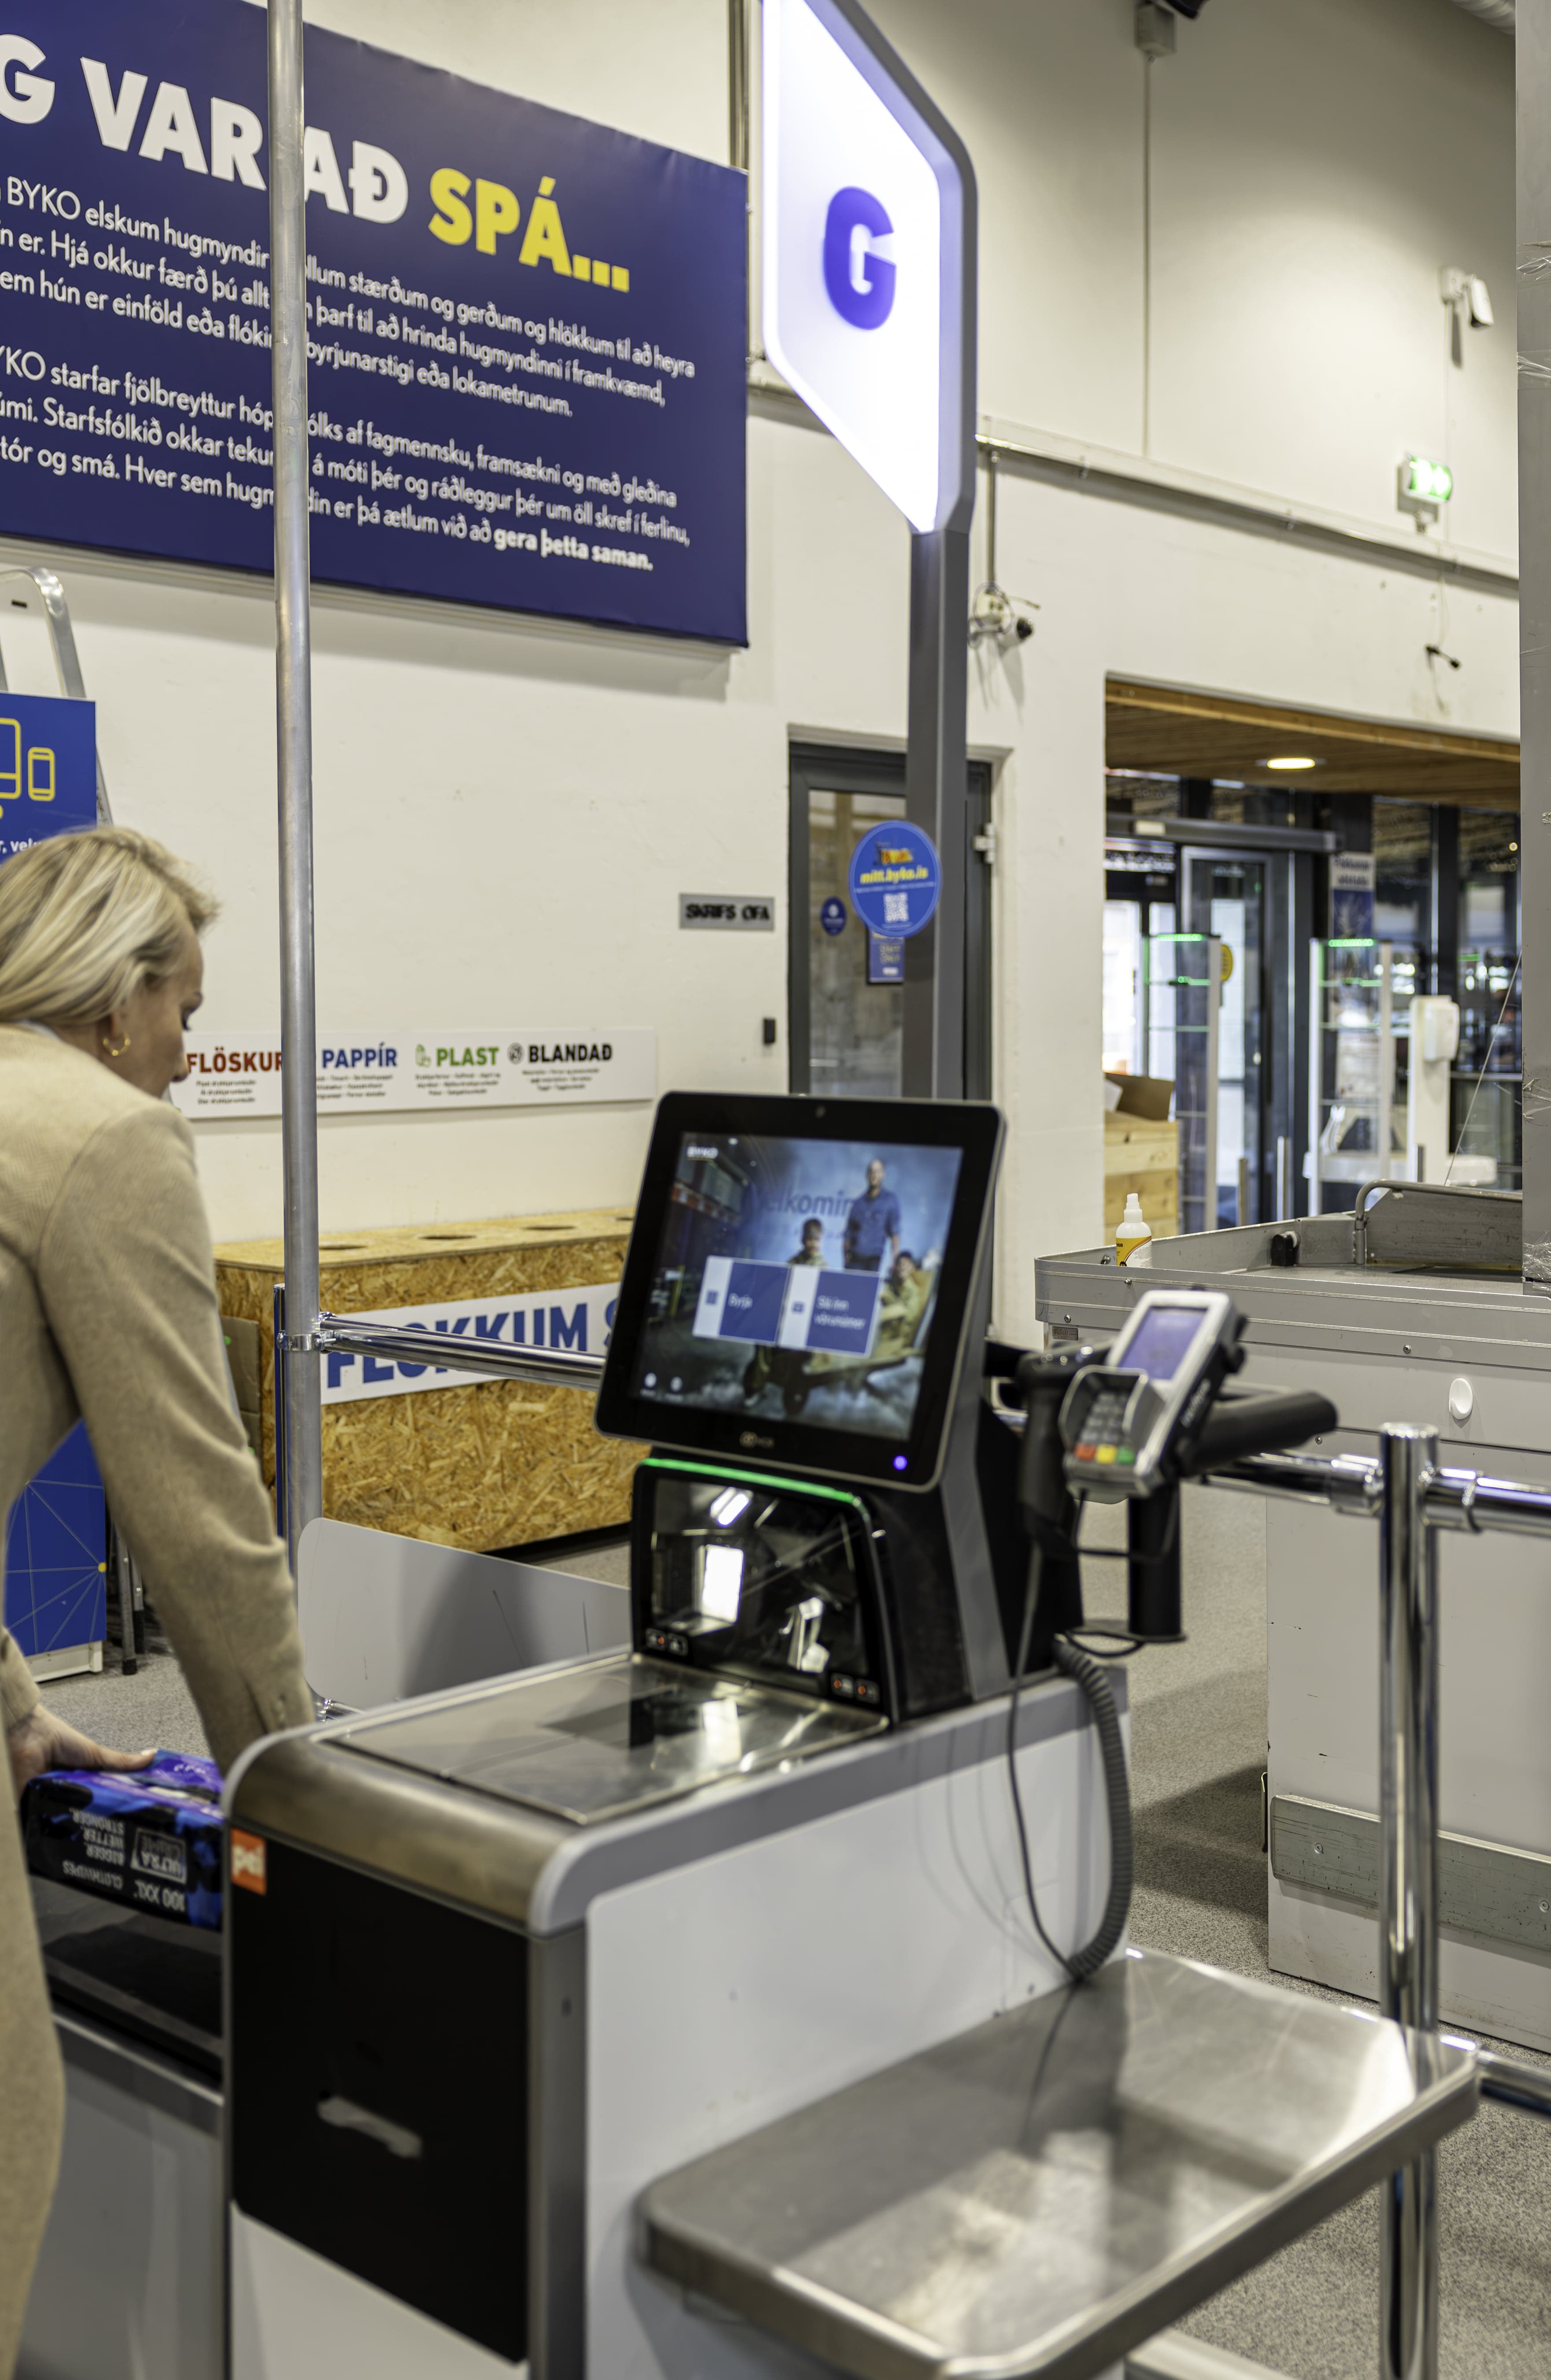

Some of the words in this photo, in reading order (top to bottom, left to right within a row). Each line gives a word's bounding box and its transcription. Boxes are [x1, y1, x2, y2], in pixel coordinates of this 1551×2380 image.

[80, 57, 267, 191] VAR
[428, 167, 629, 293] SPÁ...
[7, 176, 81, 220] BYKO
[85, 199, 160, 242] elskum
[164, 216, 270, 269] hugmyndir
[305, 254, 346, 289] llum
[348, 271, 429, 310] stærðum
[430, 296, 455, 322] og
[456, 301, 523, 335] gerðum
[524, 320, 547, 345] og
[616, 337, 631, 362] til
[632, 341, 653, 367] að
[653, 344, 695, 379] heyra
[18, 233, 46, 255] er.
[51, 229, 89, 269] Hjá
[93, 243, 155, 281] okkur
[158, 256, 209, 294] færð
[212, 269, 238, 303] þú
[241, 279, 270, 310] allt
[316, 294, 355, 330] þarf
[356, 307, 374, 335] til
[375, 312, 400, 340] að
[402, 316, 458, 355] hrinda
[459, 330, 563, 381] hugmyndinni
[822, 185, 896, 331] G
[40, 269, 81, 306] hún
[85, 291, 109, 311] er
[112, 293, 183, 329] einföld
[186, 306, 225, 338] eða
[416, 359, 450, 390] eða
[452, 365, 573, 418] lokametrunum.
[43, 396, 163, 446] Starfsfólkið
[166, 422, 225, 457] okkar
[312, 452, 325, 477] á
[328, 458, 368, 484] móti
[371, 459, 403, 492] þér
[404, 476, 429, 501] og
[431, 474, 514, 514] ráðleggur
[515, 487, 545, 518] þér
[546, 502, 572, 523] um
[51, 362, 121, 396] starfar
[124, 371, 237, 419] fjölbreyttur
[308, 410, 344, 442] ólks
[345, 419, 364, 446] af
[366, 421, 474, 472] fagmennsku,
[476, 443, 561, 485] framsækni
[562, 471, 584, 495] og
[0, 435, 34, 463] tór
[37, 448, 67, 476] og
[71, 453, 121, 480] smá.
[125, 453, 178, 489] Hver
[180, 473, 222, 497] sem
[333, 500, 355, 519] er
[357, 495, 381, 527] þá
[382, 503, 439, 535] ætlum
[441, 512, 468, 540] við
[469, 517, 492, 543] að
[493, 528, 538, 551] gera
[591, 545, 654, 572] saman.
[322, 1042, 397, 1069] PAPPÍR
[436, 1046, 500, 1067] PLAST
[529, 1043, 612, 1064] BLANDAÐ
